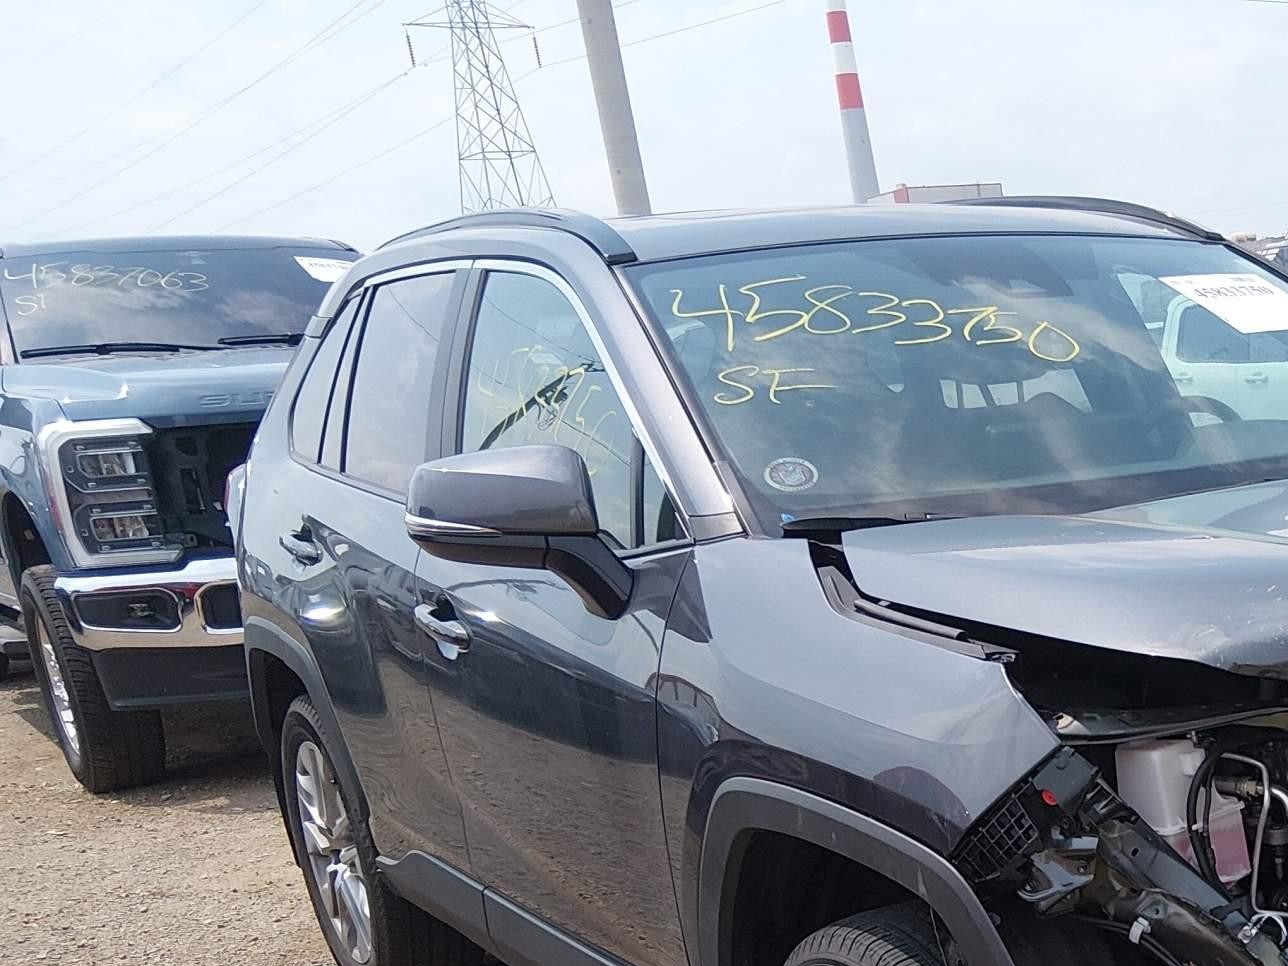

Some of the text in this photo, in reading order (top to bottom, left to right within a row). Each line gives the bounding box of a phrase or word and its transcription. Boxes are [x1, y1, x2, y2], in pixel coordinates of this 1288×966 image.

[4, 260, 209, 292] 45837063
[669, 274, 1080, 363] 45833750
[713, 365, 840, 405] SF
